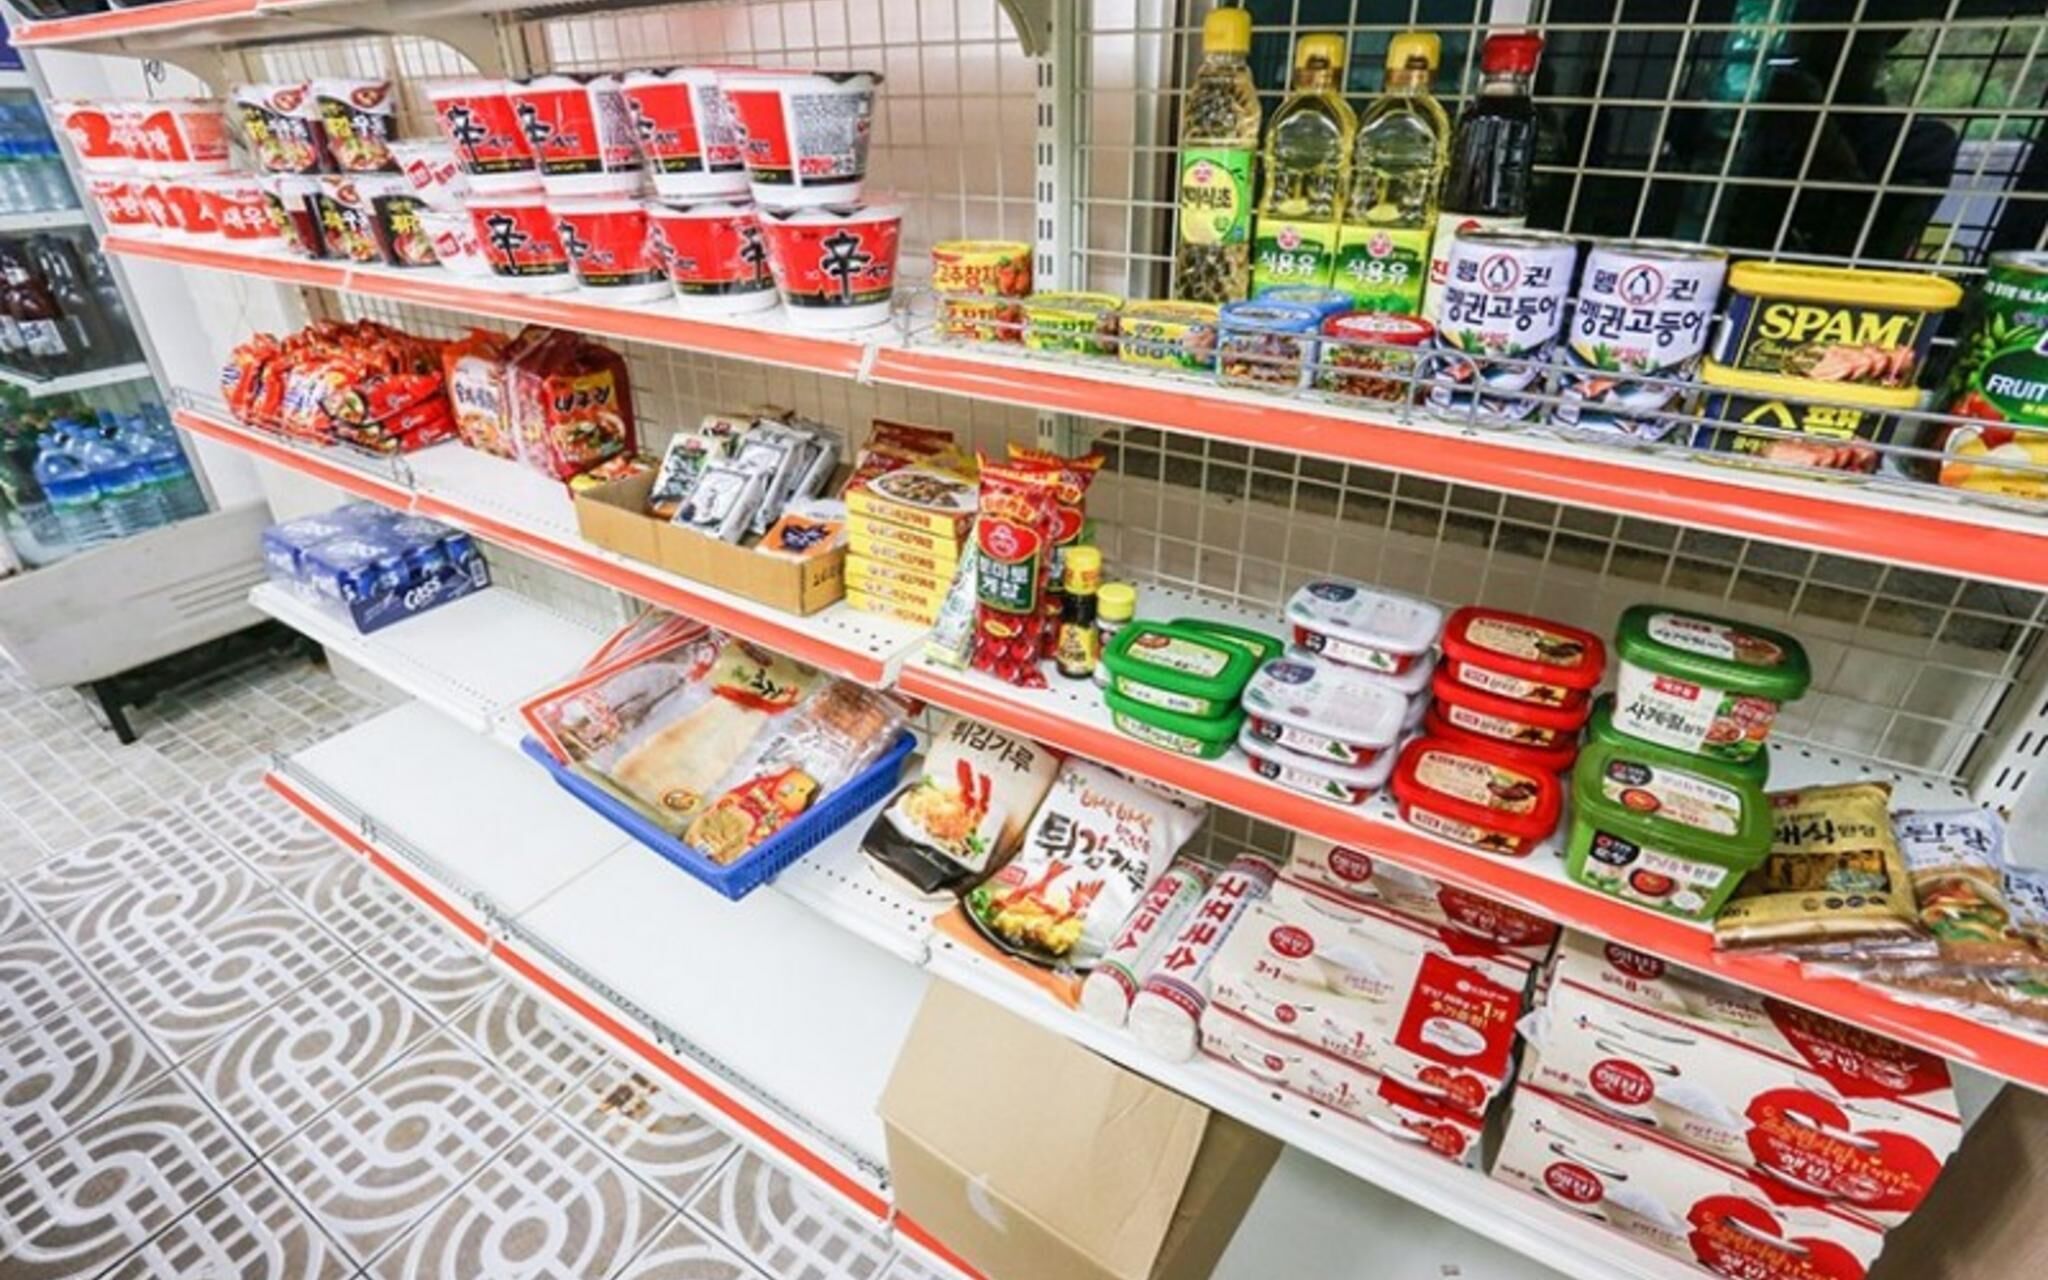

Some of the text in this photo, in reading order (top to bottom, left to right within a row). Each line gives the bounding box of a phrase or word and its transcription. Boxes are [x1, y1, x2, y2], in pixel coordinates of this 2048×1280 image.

[1261, 250, 1316, 276] 식용유
[1346, 258, 1409, 286] 식용유
[1522, 265, 1552, 289] 귄
[1665, 278, 1698, 301] 귄
[1445, 286, 1559, 332] 펭귄고등어
[1578, 299, 1705, 349] 펭귄고등어
[1758, 304, 1908, 349] SPAM
[403, 576, 442, 611] Cass
[951, 719, 1035, 773] 튀김가루
[1035, 810, 1149, 894] 튀김가루
[1163, 875, 1250, 972] 구포국수
[1596, 1067, 1651, 1101] 햇반
[1549, 1167, 1597, 1200] 햇반
[1778, 1153, 1833, 1186] 햇반
